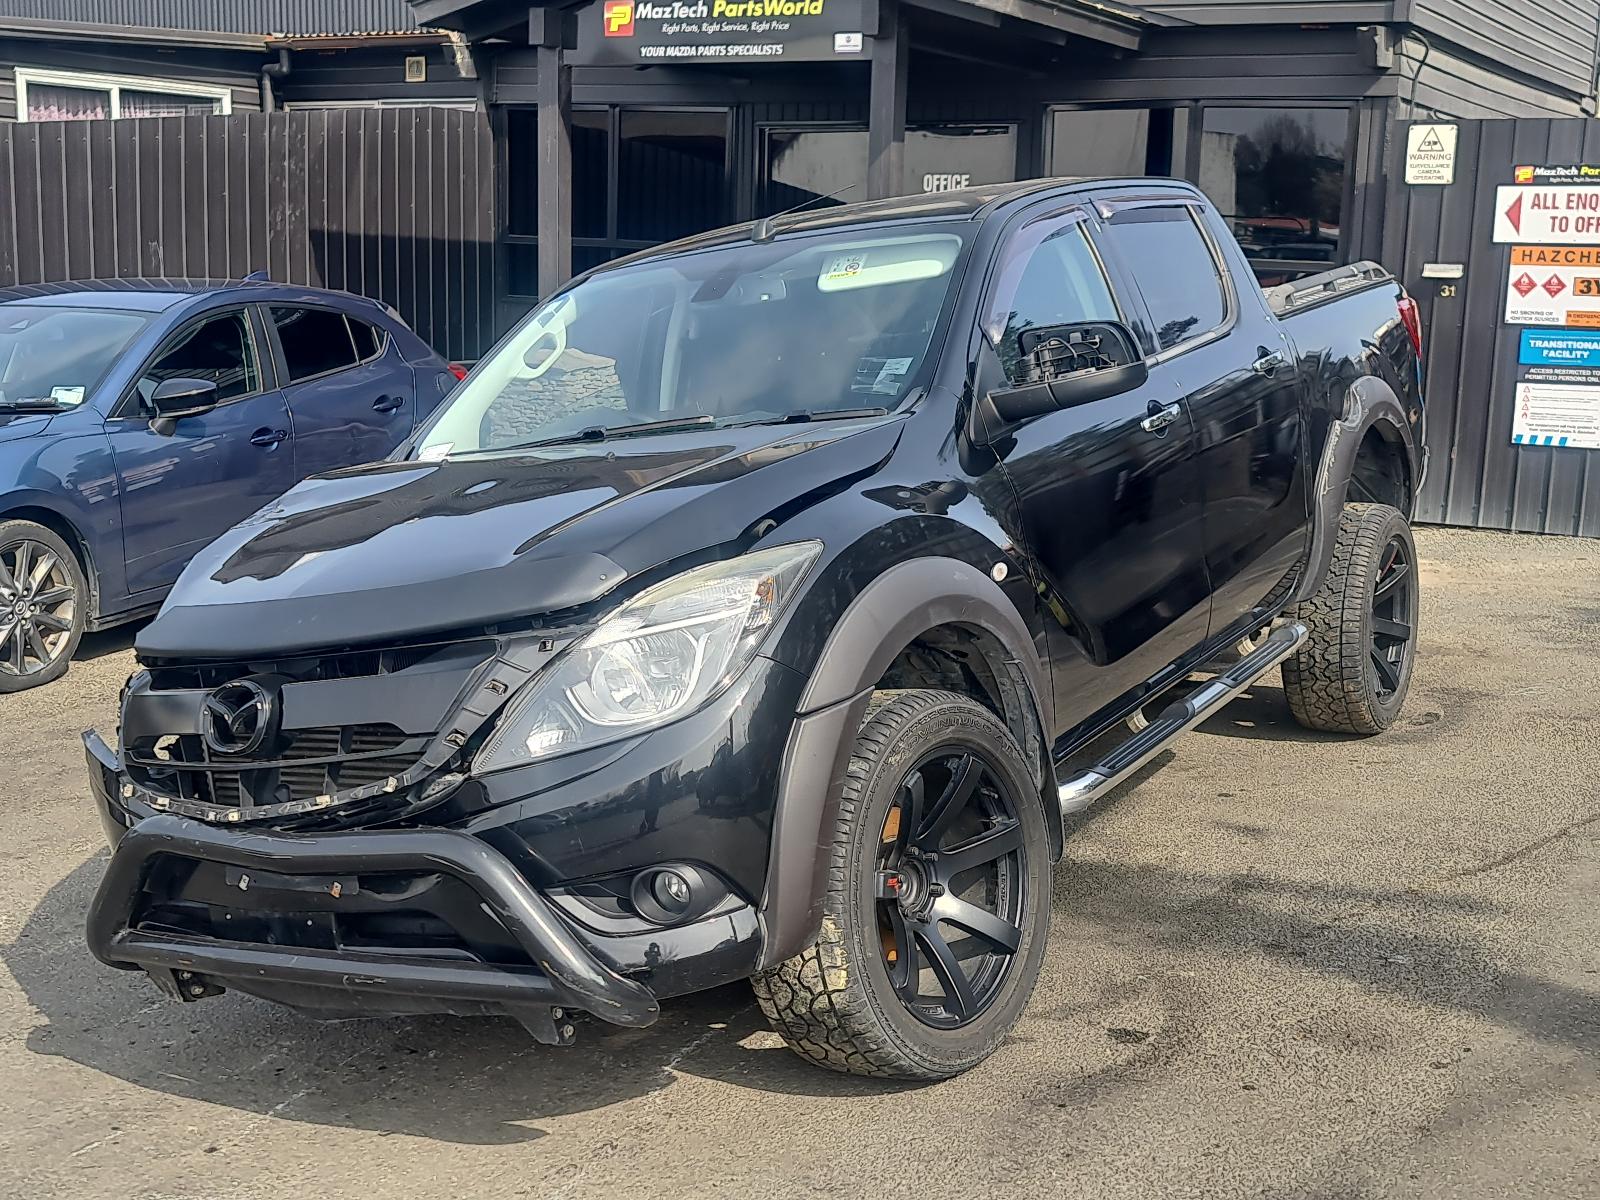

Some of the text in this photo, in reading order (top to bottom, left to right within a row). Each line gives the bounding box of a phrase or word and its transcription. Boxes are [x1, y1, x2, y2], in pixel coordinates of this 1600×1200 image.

[635, 0, 708, 19] MazTech
[712, 0, 823, 18] PartsWorld
[661, 20, 790, 35] Right Parts, Right Service, Right Price
[640, 44, 784, 57] YOUR MAZDA PARTS SPECIALISTS
[1409, 153, 1452, 161] WARNING
[1534, 165, 1579, 176] MazTech
[923, 174, 970, 192] OFFICE
[1530, 193, 1599, 213] ALL ENQ
[1550, 216, 1570, 233] TO
[1440, 285, 1457, 297] 31
[1542, 349, 1590, 359] FACILITY
[1529, 367, 1553, 375] ACCESS
[1554, 368, 1592, 376] RESTRICTED
